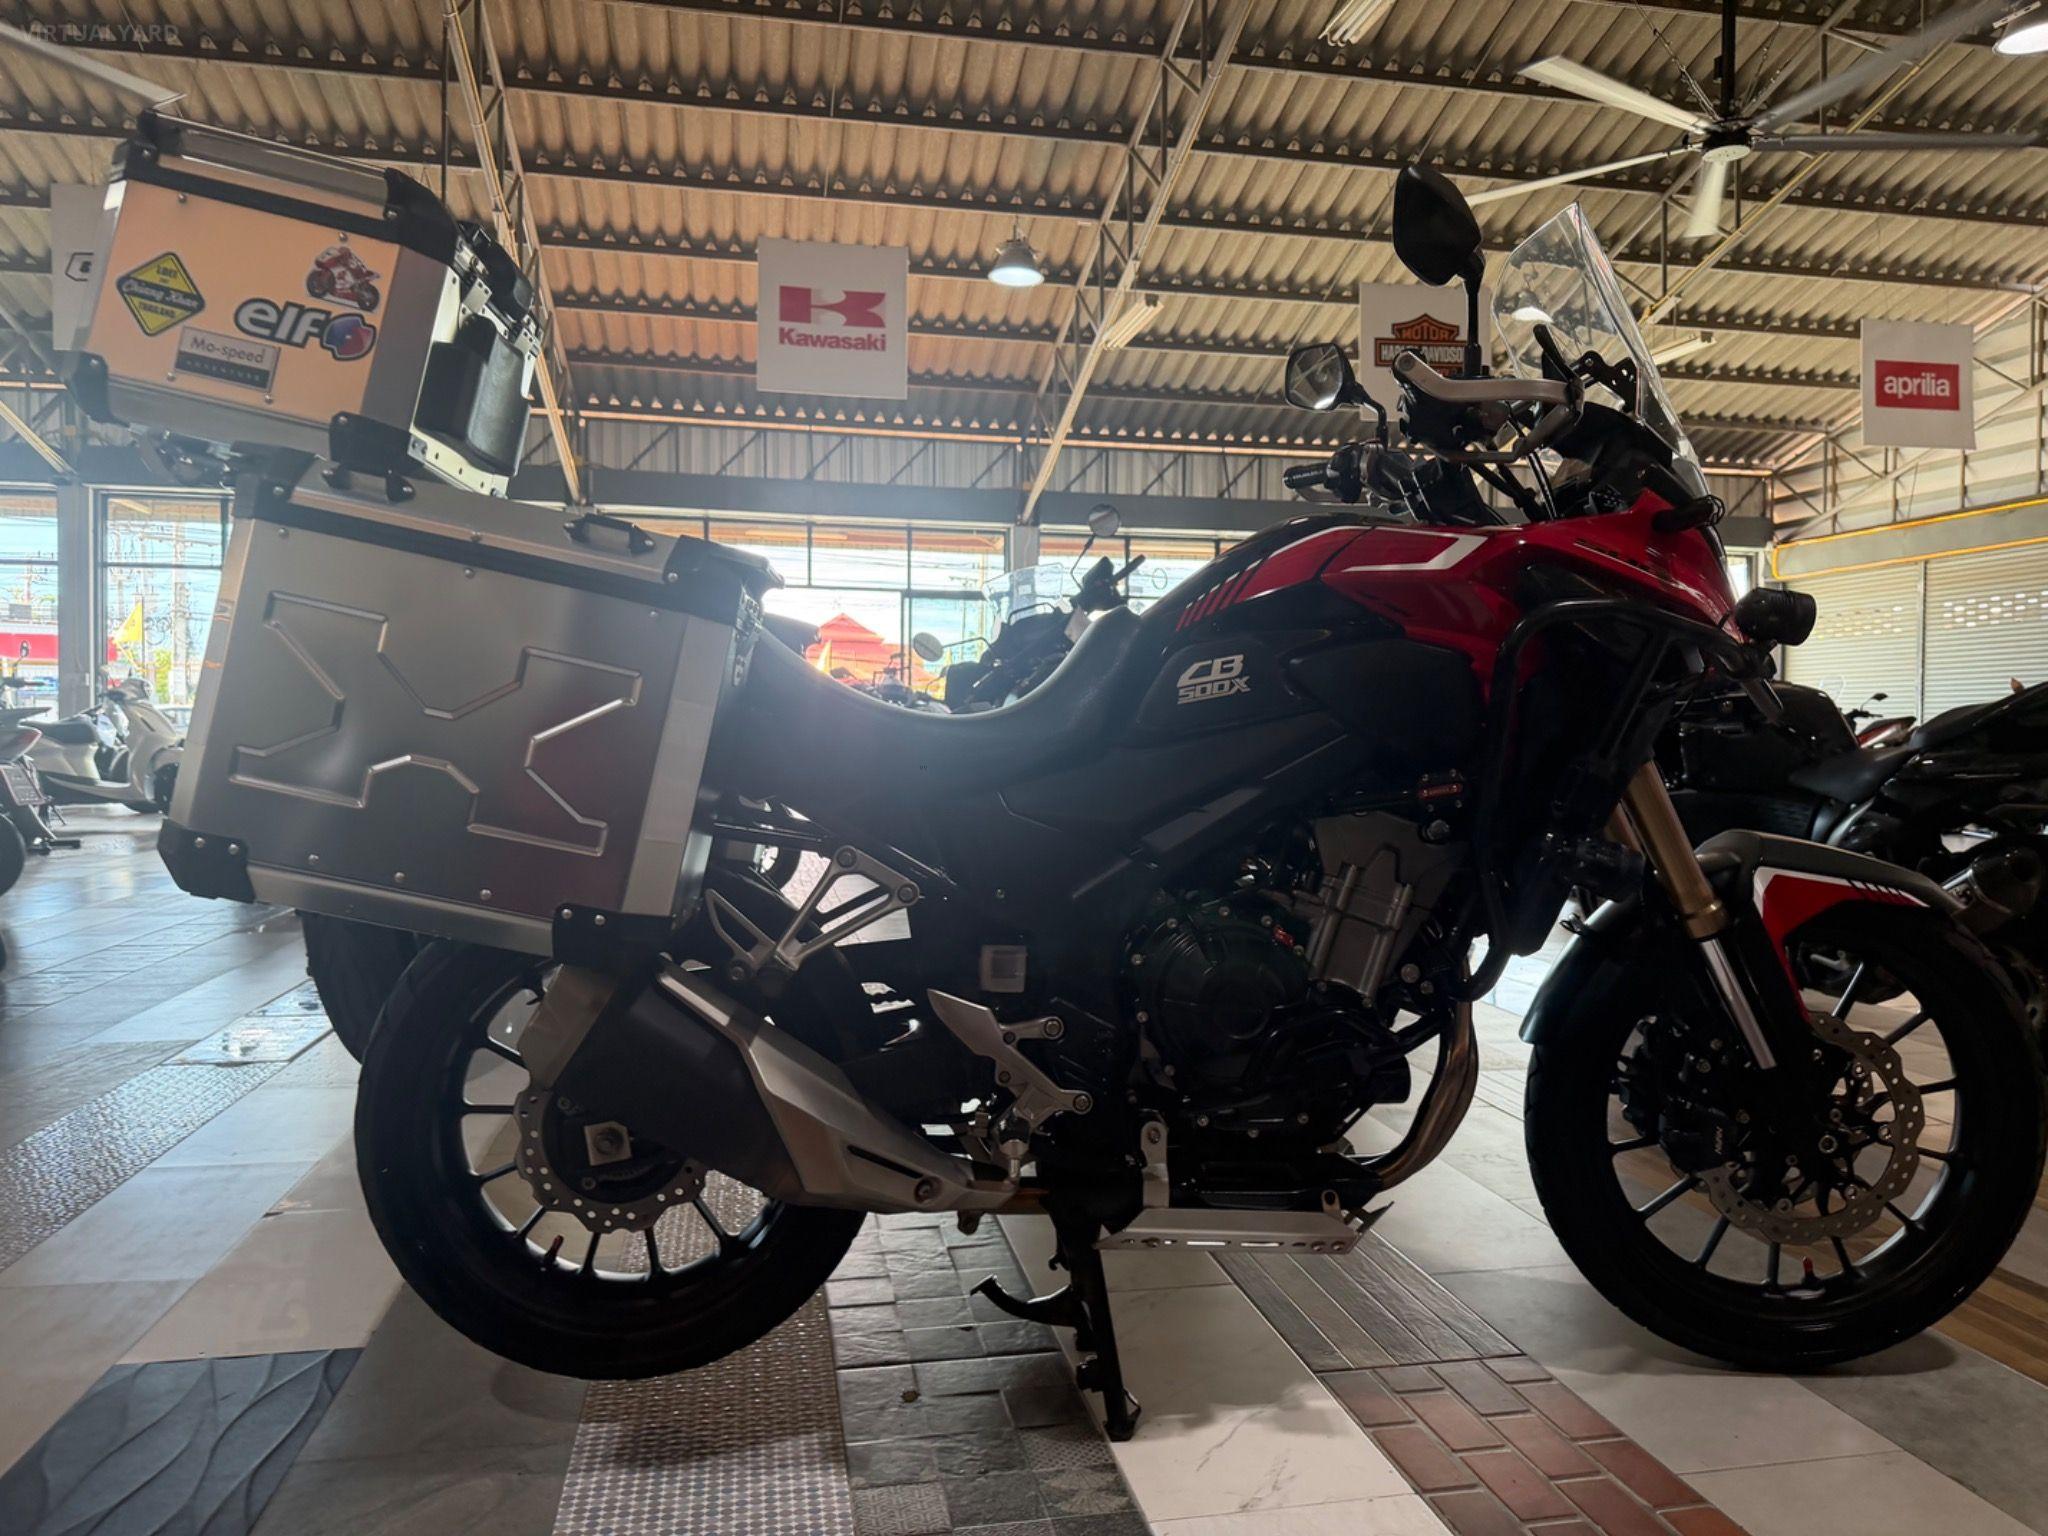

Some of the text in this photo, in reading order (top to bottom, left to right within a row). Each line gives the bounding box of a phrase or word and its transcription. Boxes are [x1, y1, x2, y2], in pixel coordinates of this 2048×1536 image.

[235, 298, 329, 348] elf
[1400, 321, 1451, 340] MOTOR
[190, 335, 265, 364] Mo-speed
[779, 326, 887, 352] Kawasaki
[1883, 372, 1951, 399] aprilia
[1176, 653, 1245, 689] CB
[1177, 675, 1252, 705] 500X
